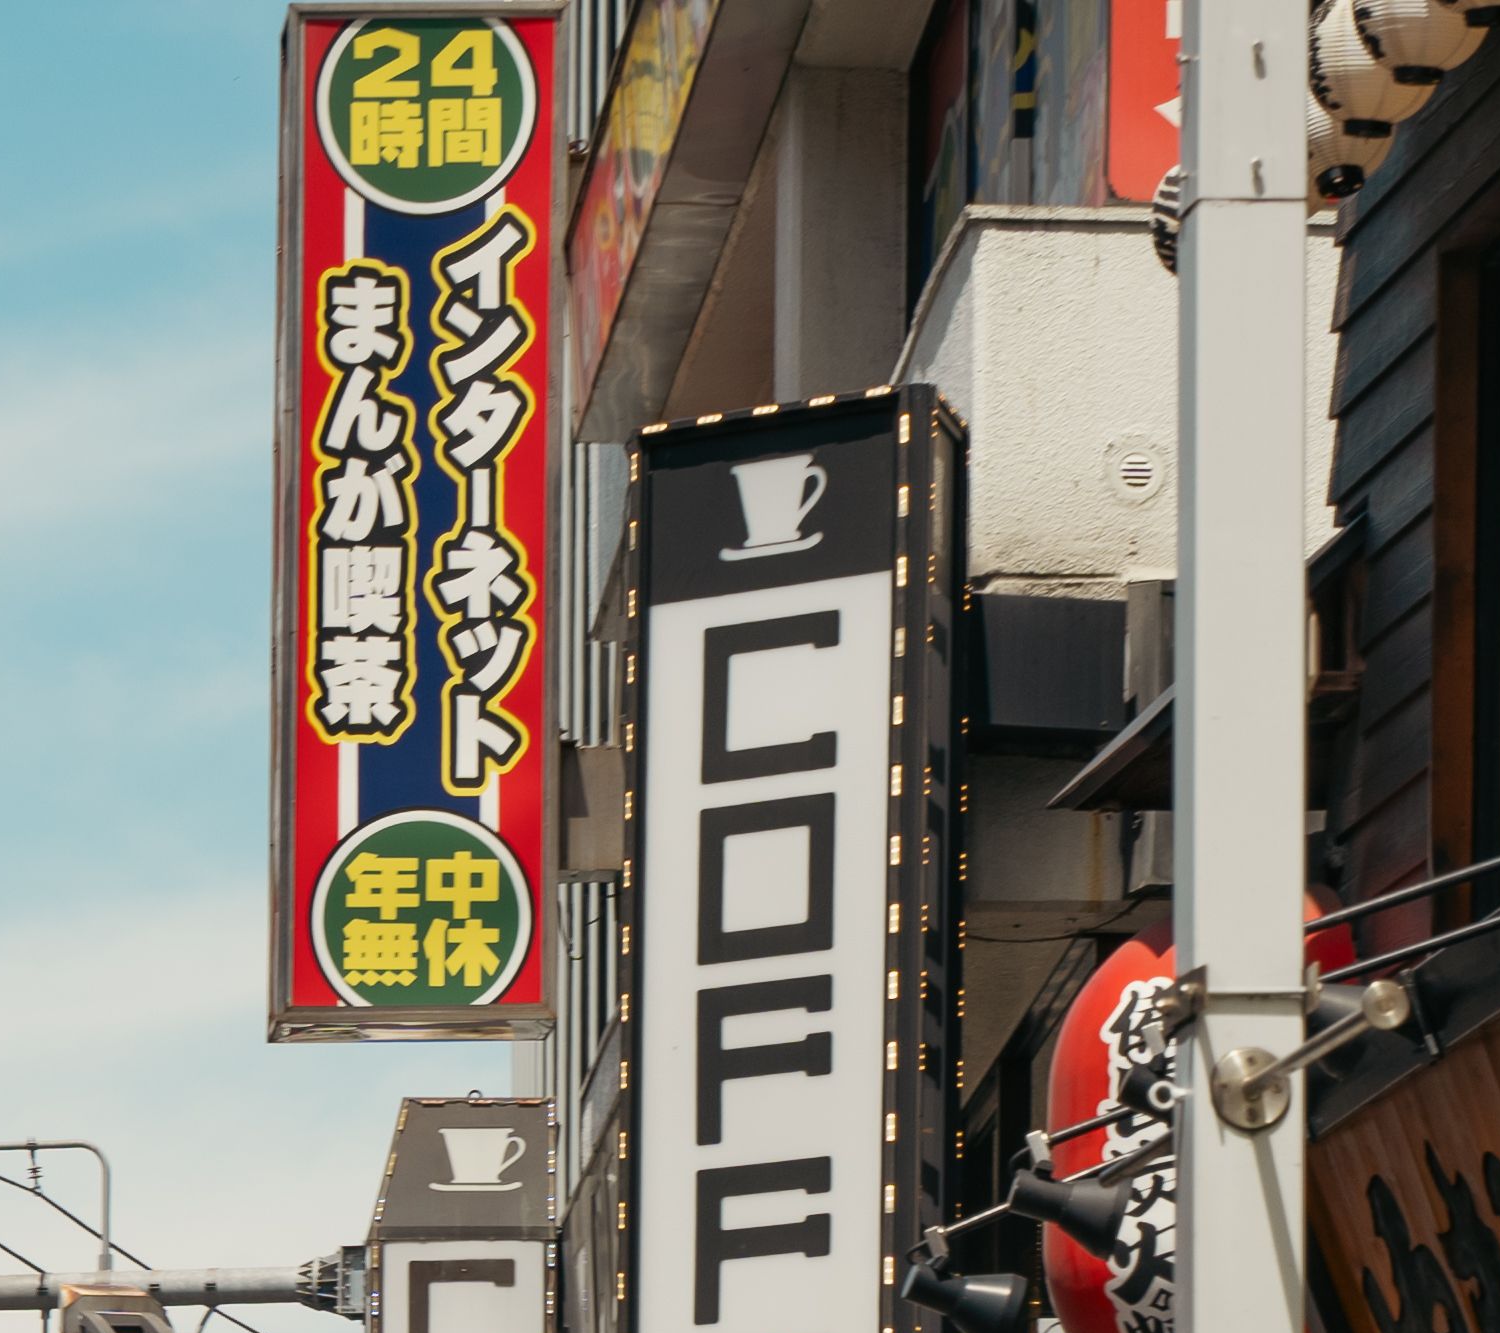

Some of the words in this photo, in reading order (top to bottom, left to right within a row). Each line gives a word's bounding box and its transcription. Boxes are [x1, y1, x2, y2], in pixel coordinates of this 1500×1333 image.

[351, 28, 499, 97] 24
[350, 98, 502, 170] 時間
[319, 272, 407, 730] まんが喫茶
[438, 212, 530, 790] インターネット
[345, 853, 501, 916] 年中
[342, 917, 502, 989] 無休
